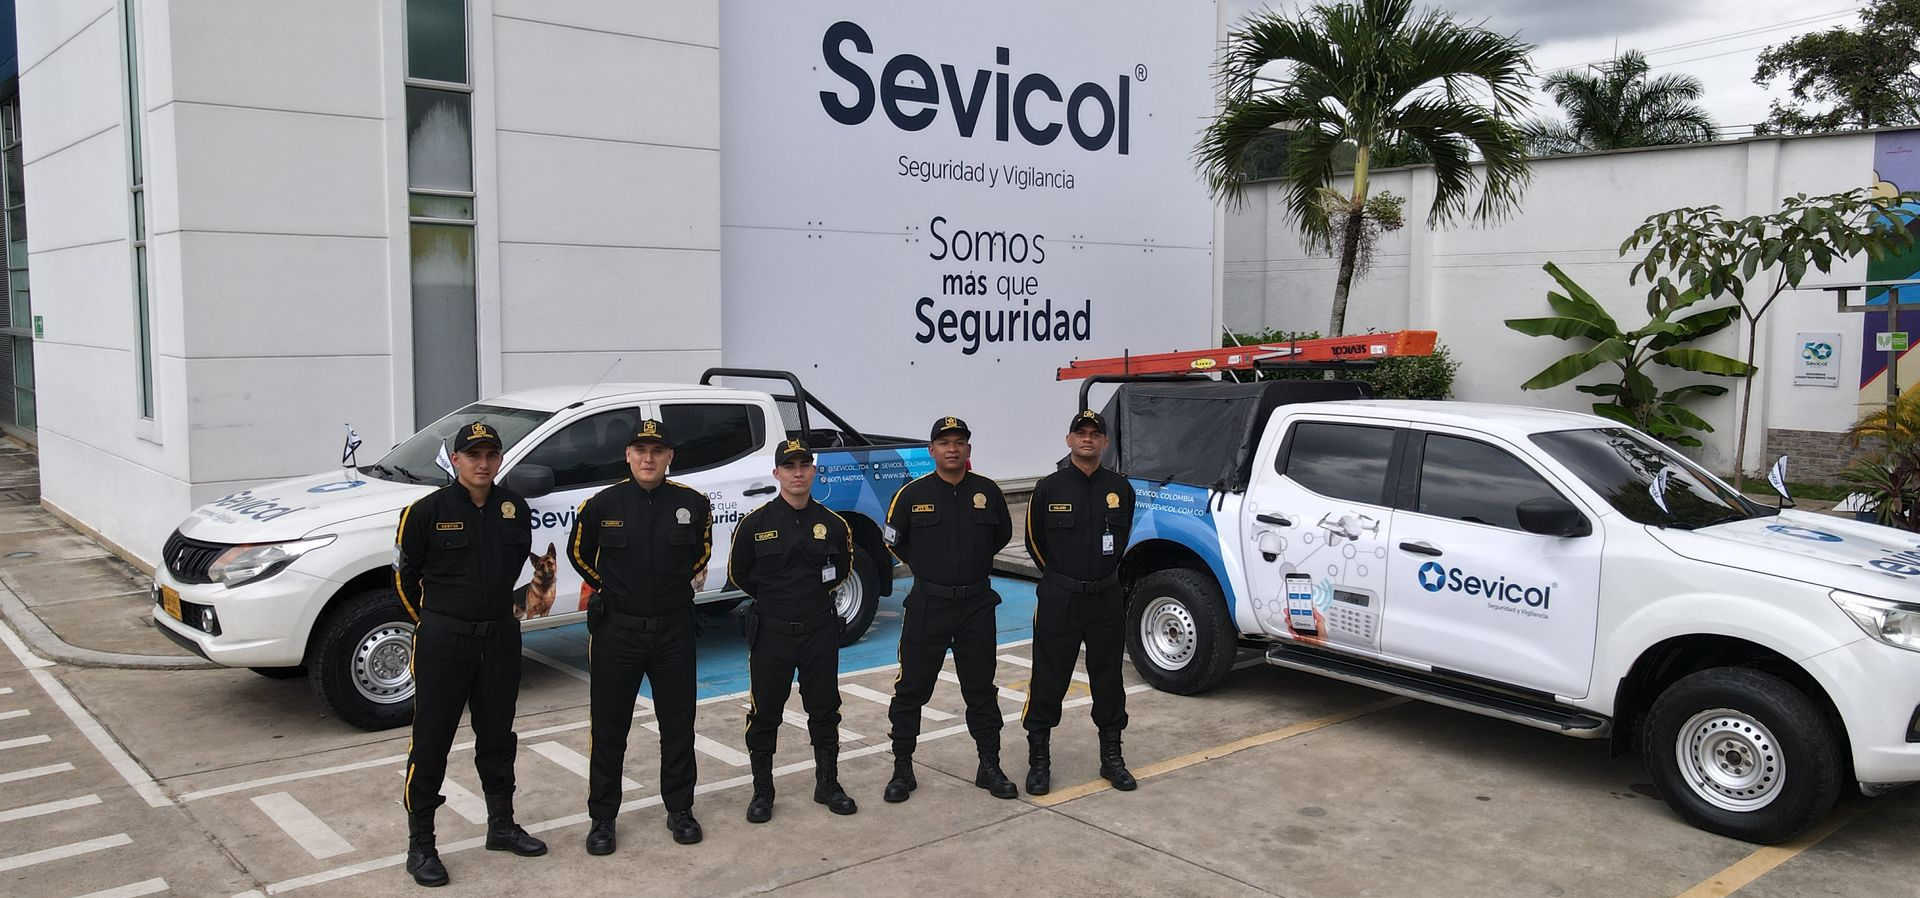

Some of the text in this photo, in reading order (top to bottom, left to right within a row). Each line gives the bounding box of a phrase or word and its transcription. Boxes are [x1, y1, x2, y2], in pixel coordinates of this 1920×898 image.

[819, 20, 1130, 156] Sevicol
[898, 155, 1075, 190] Seguridad y Vigilancia
[929, 215, 1046, 265] Somos
[942, 270, 1039, 301] más que
[915, 296, 1091, 356] Seguridad
[1332, 344, 1367, 356] SEVICOL
[717, 501, 738, 512] que
[1135, 488, 1195, 503] SEVICOL COLOMBIA
[530, 505, 579, 530] Sevi
[1447, 567, 1551, 610] Sevicol
[1487, 602, 1516, 613] Seguridad
[1521, 608, 1549, 620] Vigilancia
